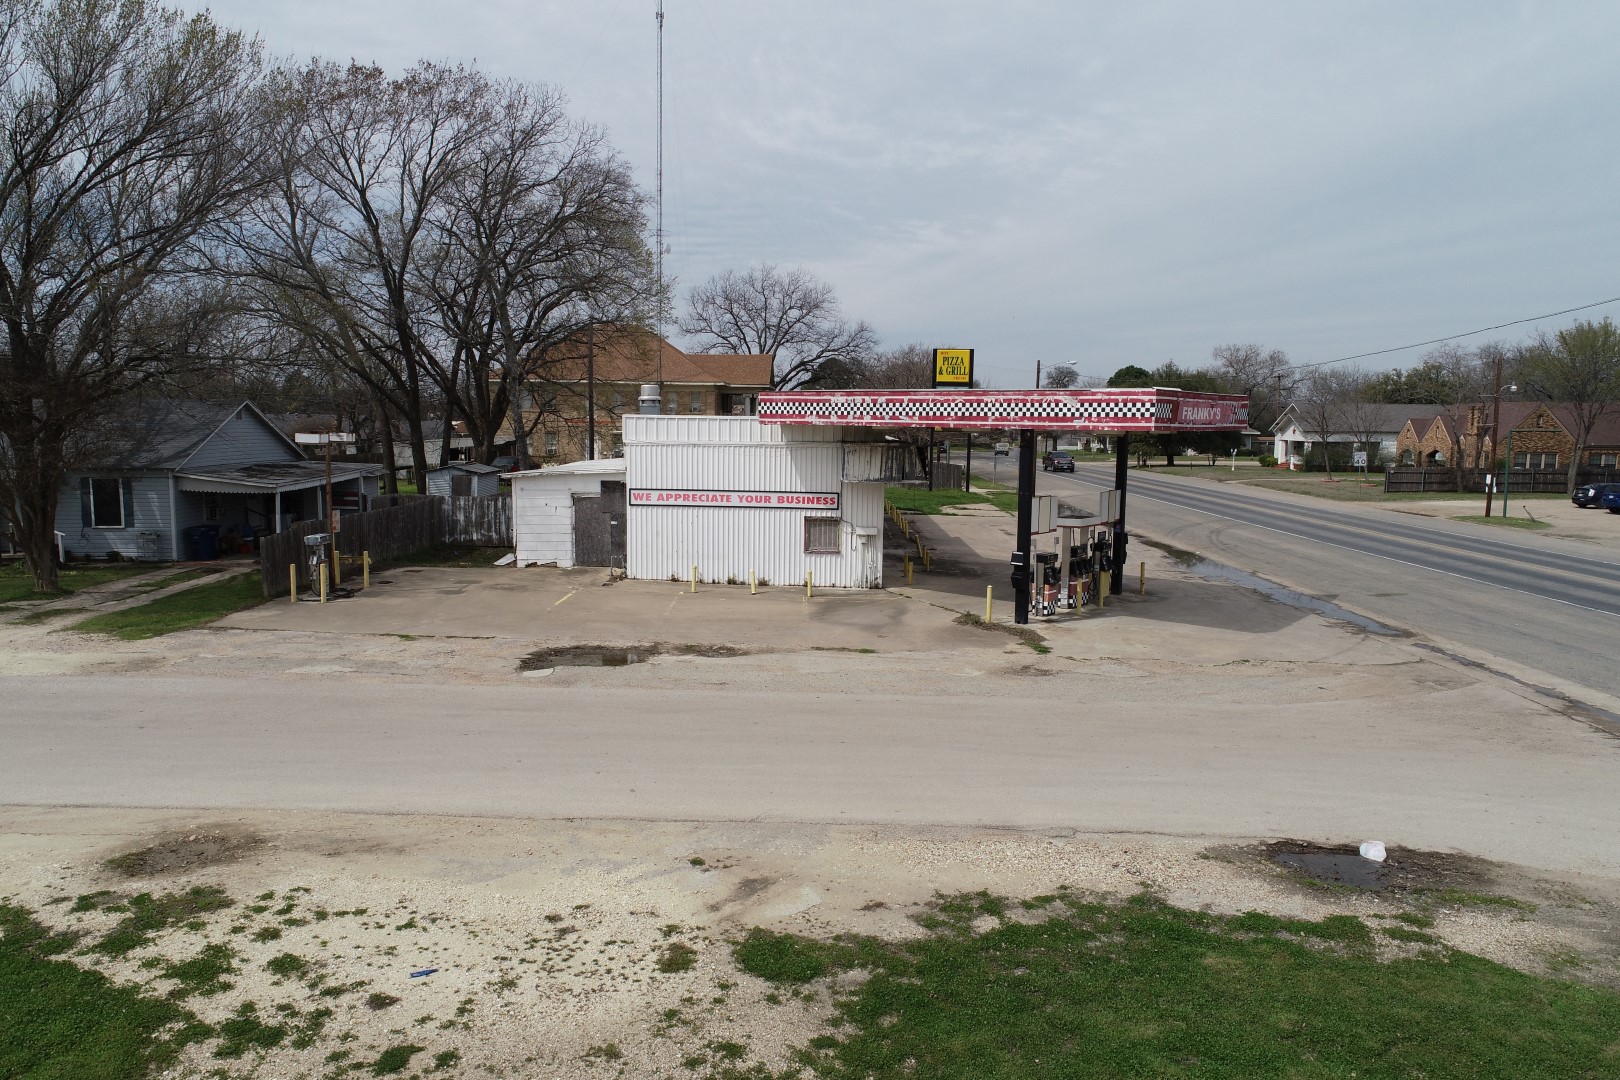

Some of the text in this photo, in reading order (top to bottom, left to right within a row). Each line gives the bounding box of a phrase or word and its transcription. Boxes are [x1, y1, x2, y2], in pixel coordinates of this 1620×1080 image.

[942, 356, 965, 366] PIZZA
[938, 366, 968, 376] & GRILL
[1182, 407, 1221, 420] FRANKY'S
[632, 493, 836, 506] WE APPRECIATE YOUR BUSINESS
